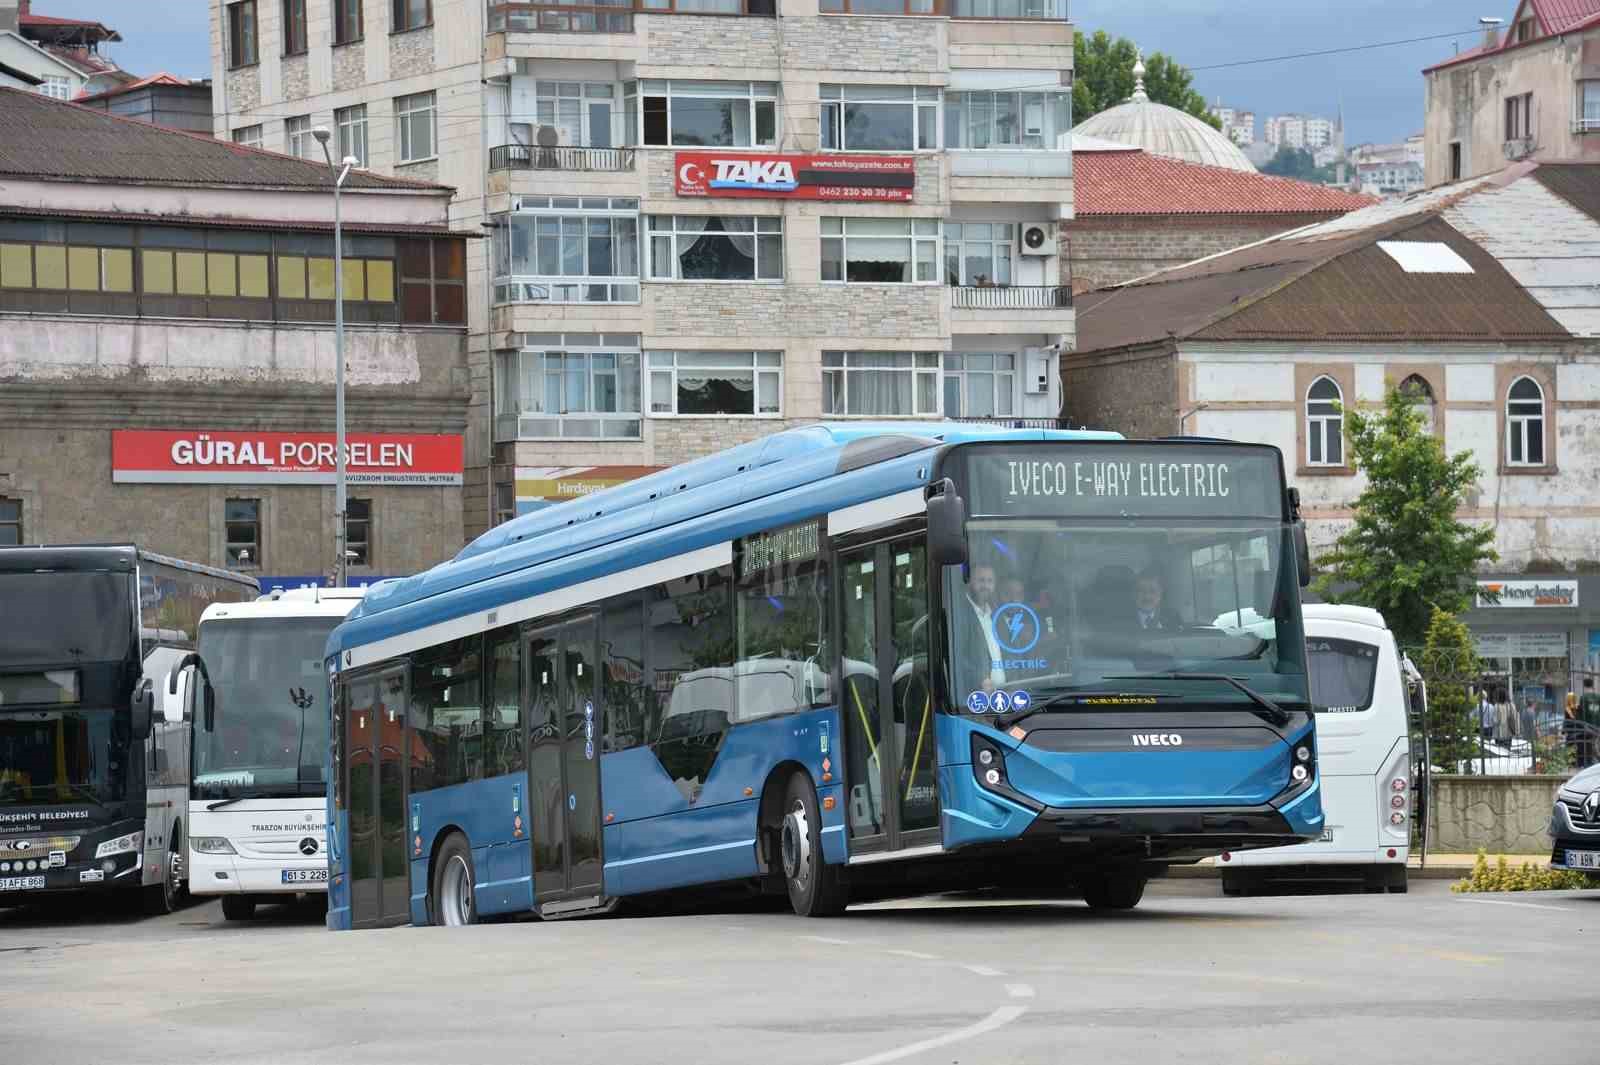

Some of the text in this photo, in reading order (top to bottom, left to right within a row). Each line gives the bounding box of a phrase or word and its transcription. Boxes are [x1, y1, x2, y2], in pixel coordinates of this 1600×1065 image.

[711, 159, 795, 183] TAKA
[820, 187, 840, 196] 0462
[843, 187, 859, 196] 230
[861, 188, 873, 196] 30
[875, 188, 886, 196] 30
[171, 434, 275, 465] GÜRAL
[1008, 462, 1229, 496] IVECO E-WAY ELECTRIC
[992, 659, 1049, 669] ELECTRIC
[1132, 734, 1183, 746] IVECO
[40, 809, 89, 820] BELEDİYESİ
[0, 825, 41, 833] ercedes-Benz
[287, 870, 327, 880] 61 S 228
